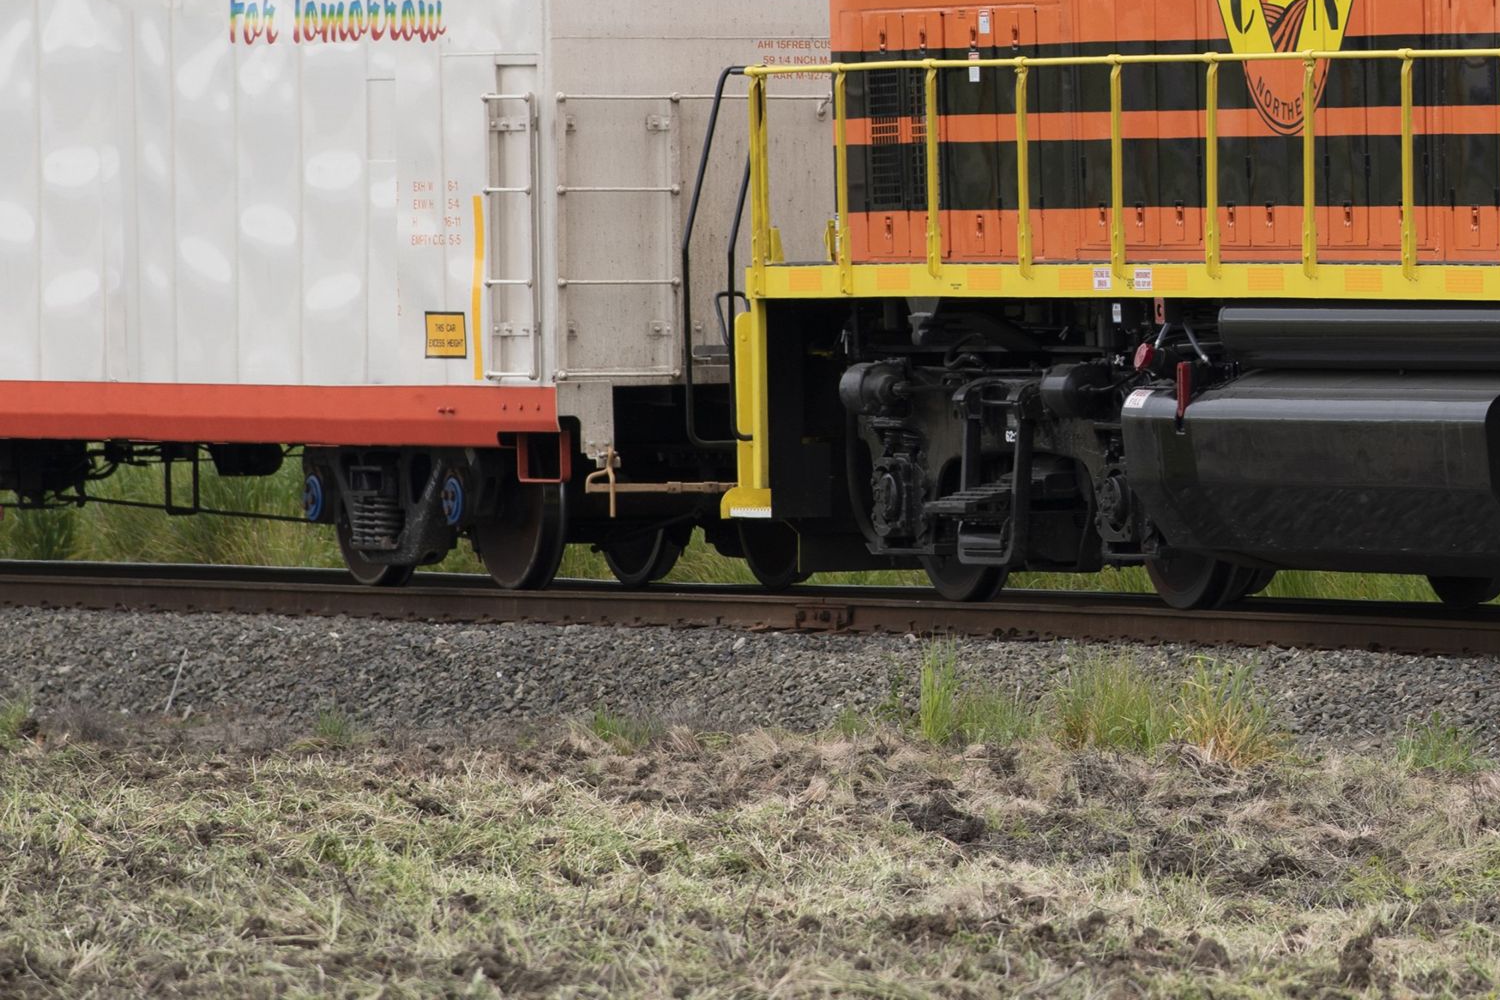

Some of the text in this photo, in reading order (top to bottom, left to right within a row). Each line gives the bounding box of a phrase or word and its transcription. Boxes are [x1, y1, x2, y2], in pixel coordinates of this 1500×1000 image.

[757, 40, 773, 49] AHI
[763, 55, 775, 64] 59
[794, 55, 816, 64] INCH
[446, 323, 456, 333] CAR
[428, 338, 463, 348] EXCESS HEIGHT
